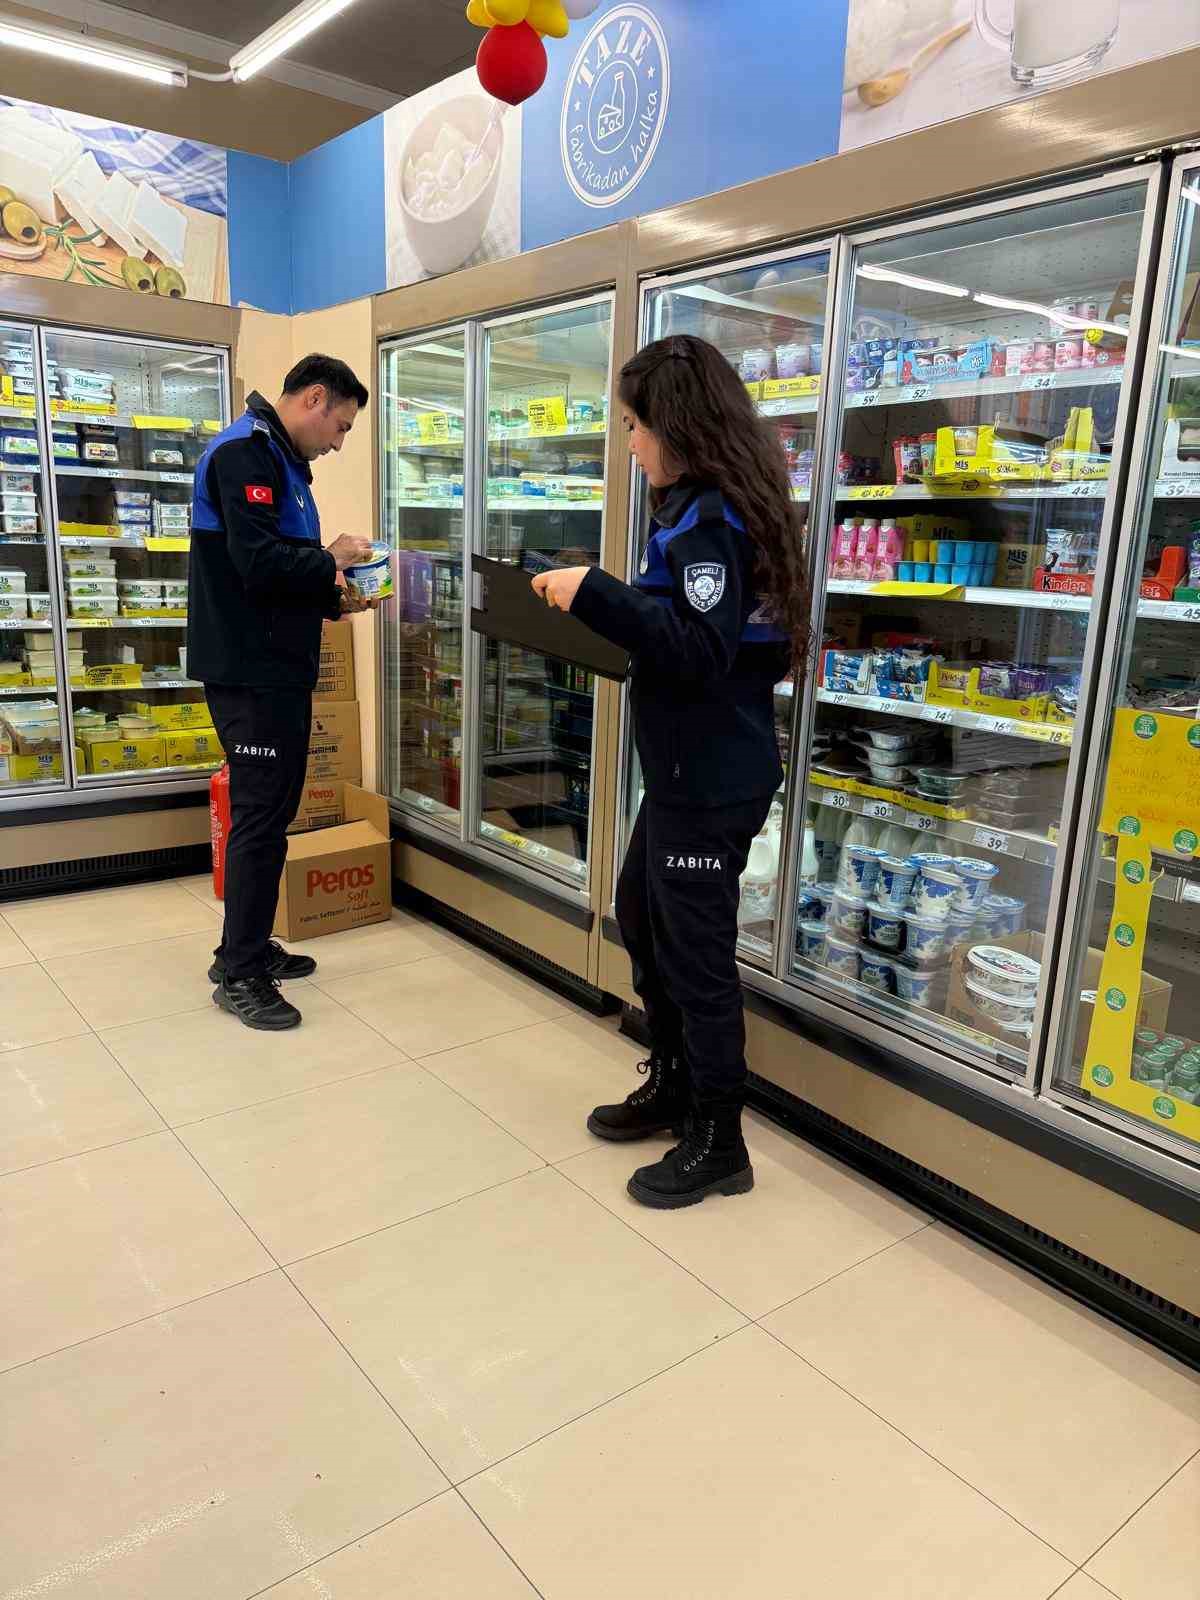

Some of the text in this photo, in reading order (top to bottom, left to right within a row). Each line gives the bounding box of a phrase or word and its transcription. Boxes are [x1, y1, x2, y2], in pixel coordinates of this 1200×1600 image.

[577, 21, 652, 88] TAZE
[570, 90, 659, 190] fabrikadan halka
[1041, 573, 1087, 593] Kinder
[235, 744, 277, 758] ZABITA
[666, 856, 722, 870] ZABITA
[306, 864, 376, 898] Peros
